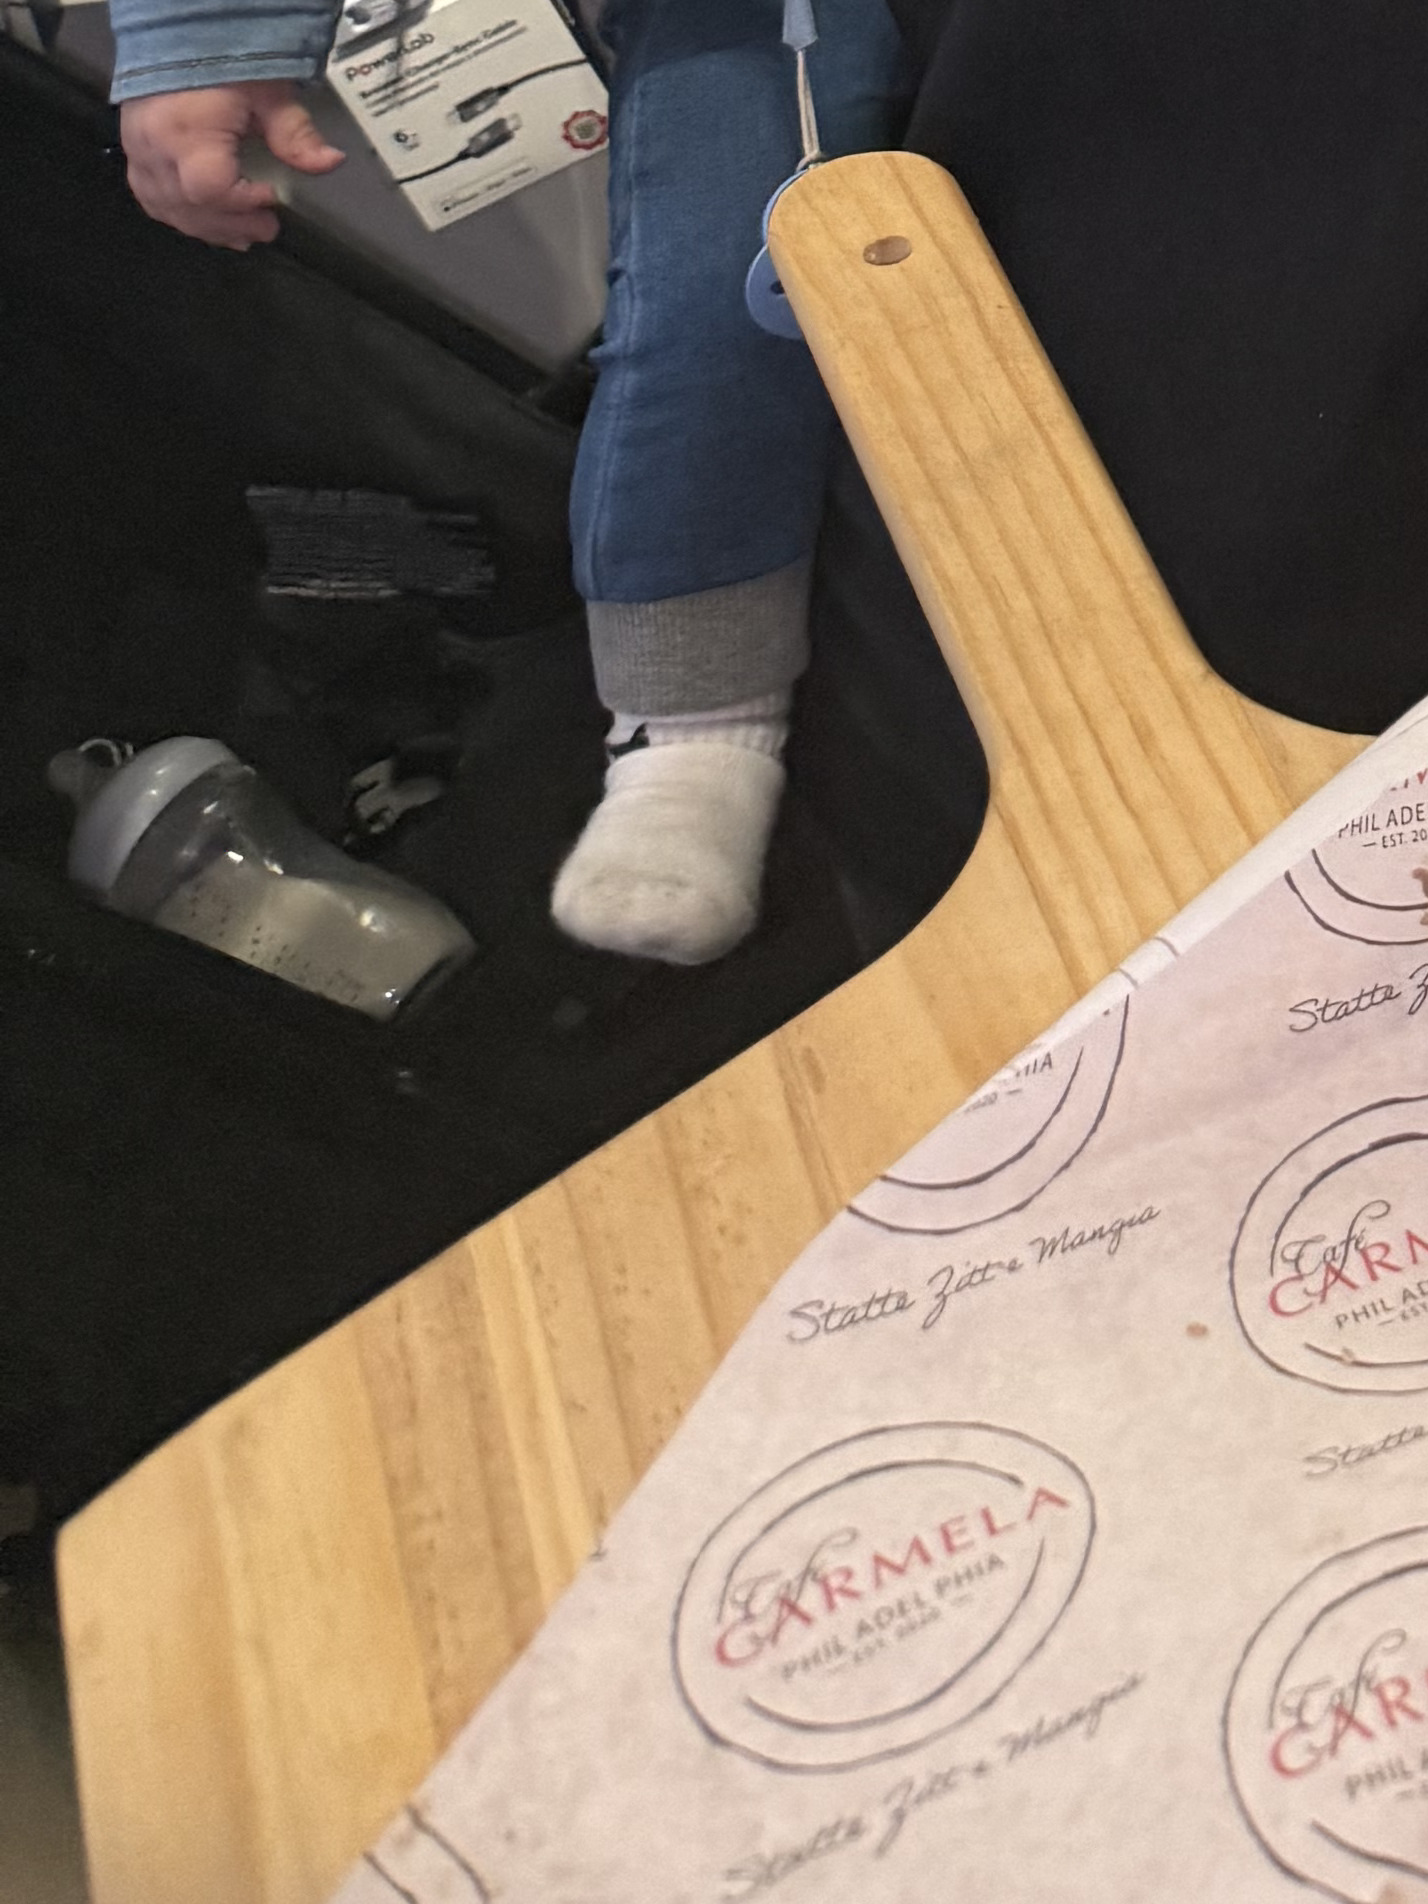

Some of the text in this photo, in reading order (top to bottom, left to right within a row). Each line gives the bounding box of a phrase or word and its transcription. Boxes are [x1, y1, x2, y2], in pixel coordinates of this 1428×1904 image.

[1028, 1204, 1162, 1265] Mangia
[1280, 1199, 1392, 1297] Café
[713, 1486, 1072, 1670] CARMELA
